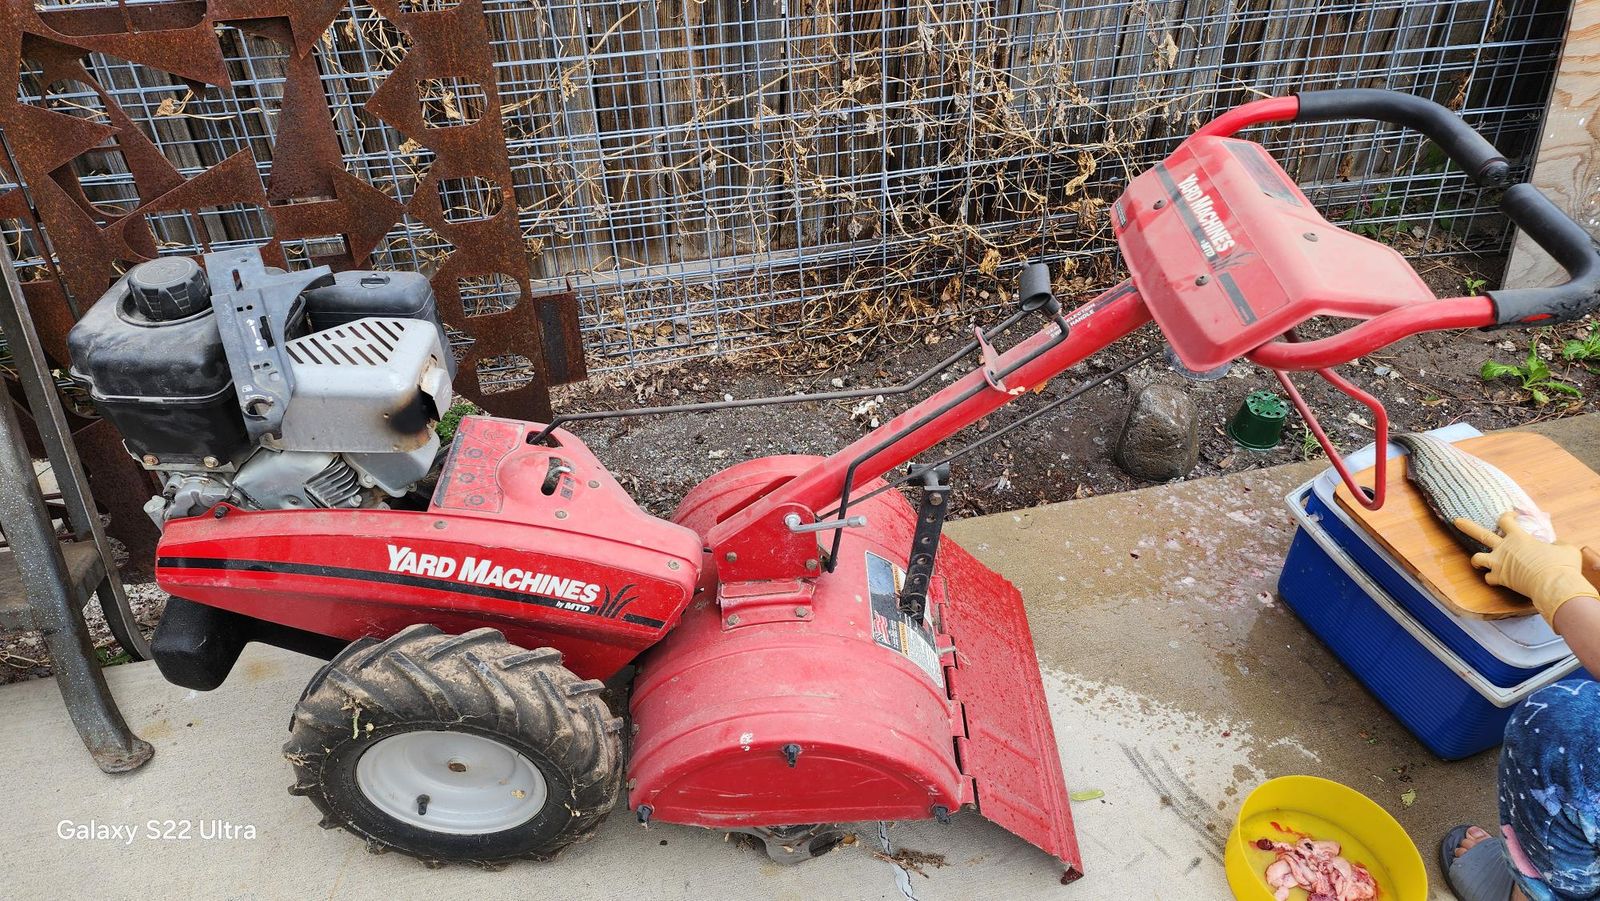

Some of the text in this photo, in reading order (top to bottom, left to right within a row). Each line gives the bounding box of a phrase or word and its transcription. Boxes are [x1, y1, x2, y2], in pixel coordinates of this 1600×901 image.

[1178, 173, 1235, 252] YARD MACHINES
[387, 544, 600, 603] YARD MACHINES
[555, 600, 591, 612] by MTD
